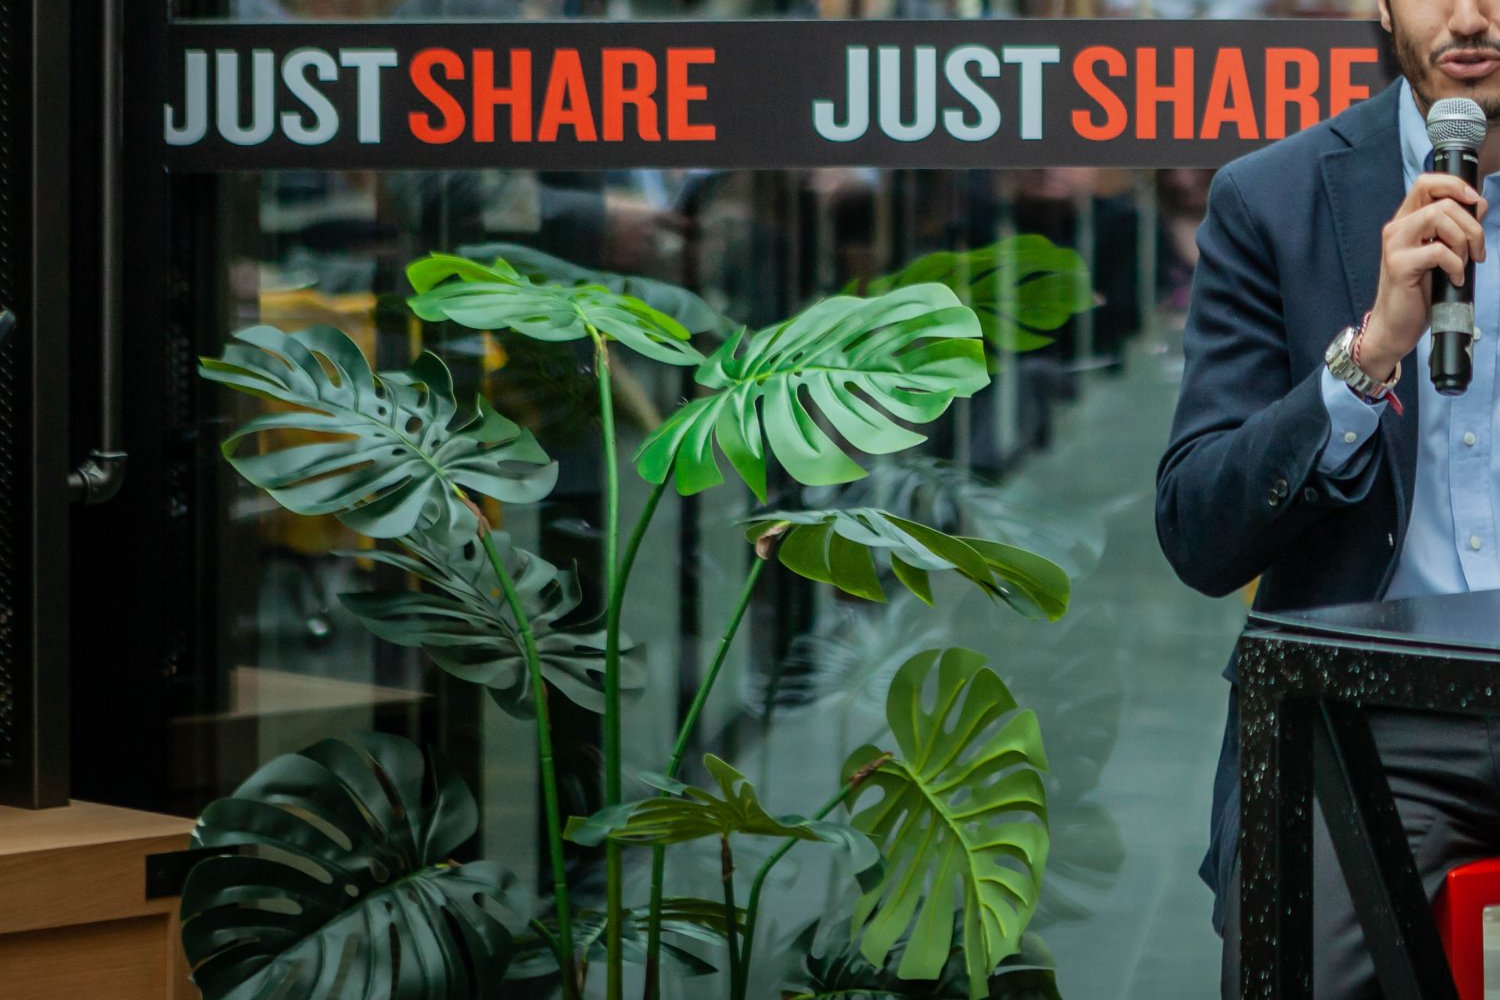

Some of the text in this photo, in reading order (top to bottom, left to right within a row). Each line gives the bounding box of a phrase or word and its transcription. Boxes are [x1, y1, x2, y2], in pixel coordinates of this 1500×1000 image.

[164, 48, 717, 145] JUST SHARE
[812, 45, 1061, 143] JUST
